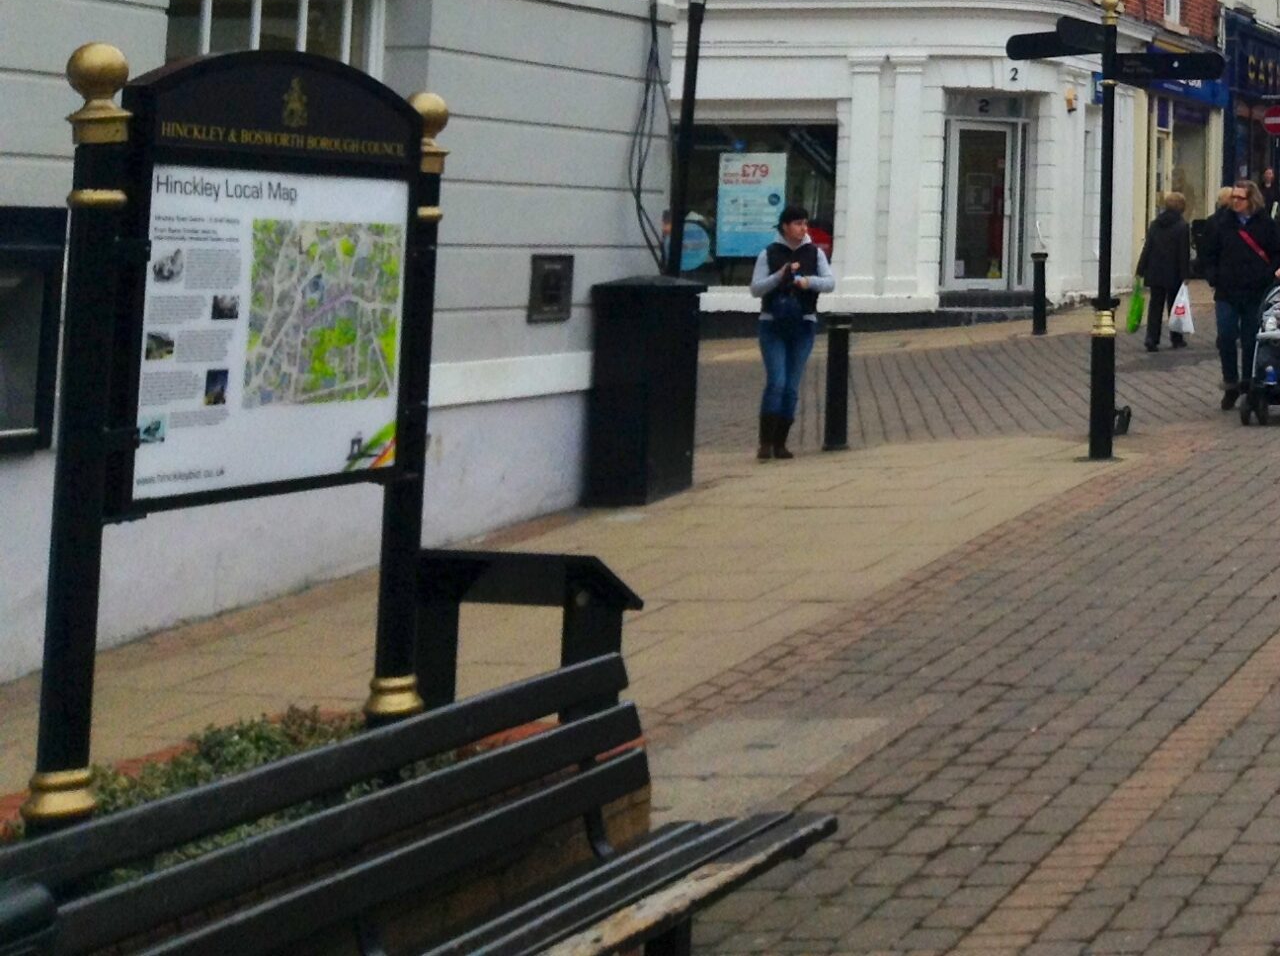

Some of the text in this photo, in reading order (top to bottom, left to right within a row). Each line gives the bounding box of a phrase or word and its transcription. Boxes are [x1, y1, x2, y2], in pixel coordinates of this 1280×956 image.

[1010, 67, 1019, 82] 2
[979, 99, 990, 114] 2
[161, 121, 405, 157] HINCKLEY & BOSWORTH BOROUGH COUNCIL
[742, 164, 770, 178] £79
[156, 174, 298, 205] Hinckley Local Map
